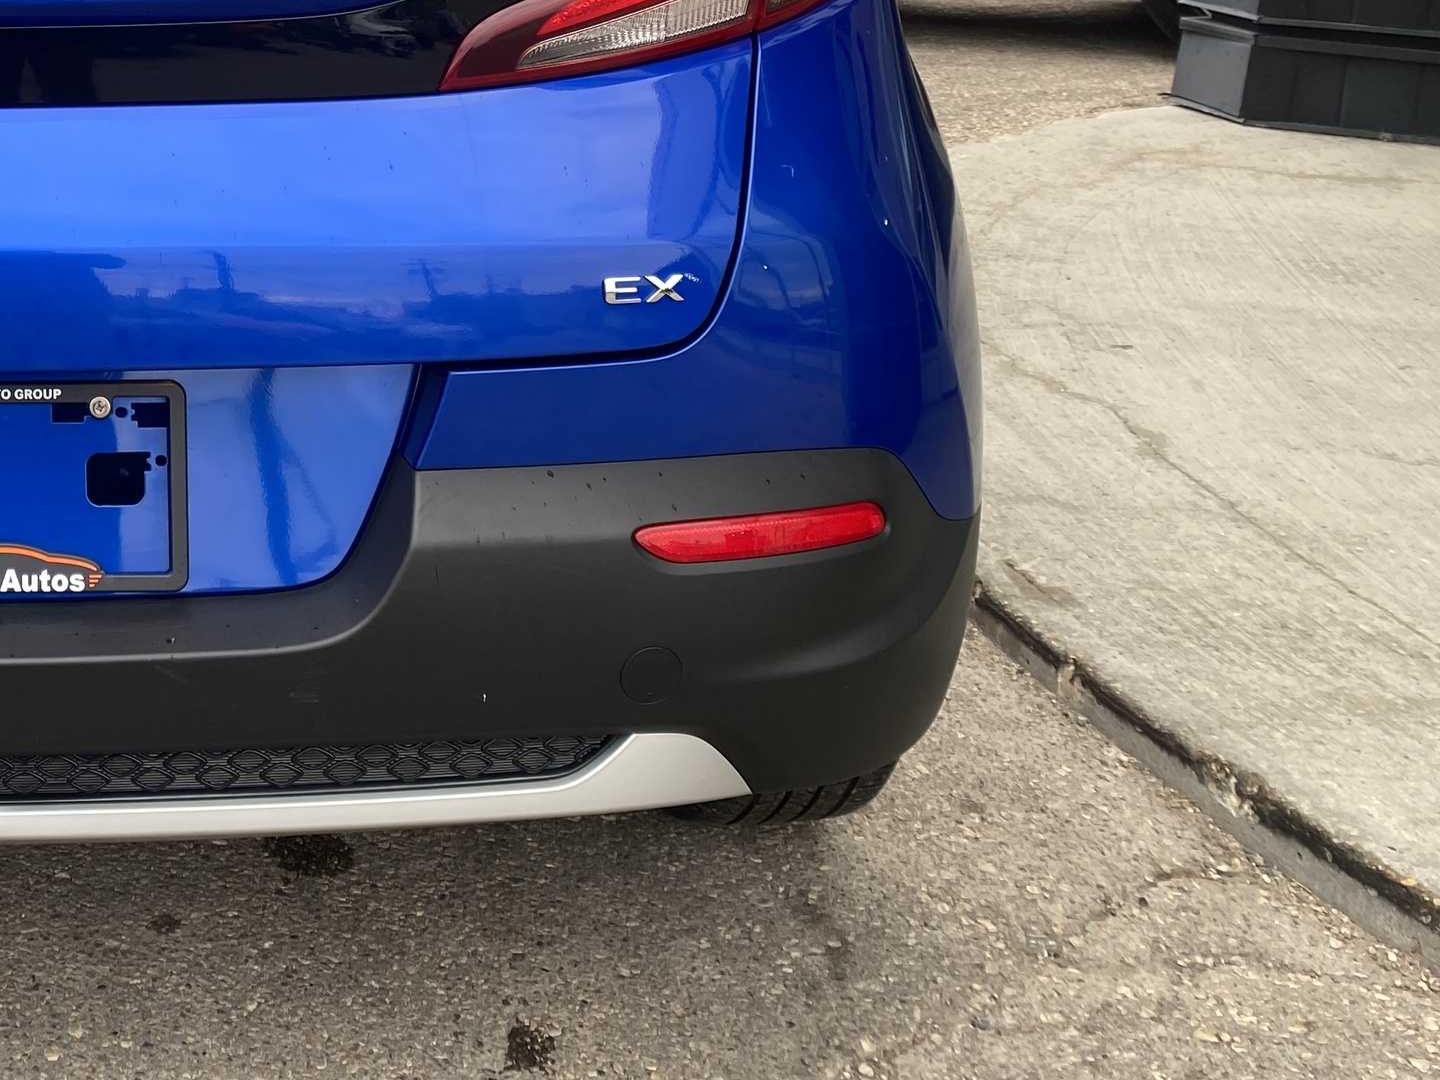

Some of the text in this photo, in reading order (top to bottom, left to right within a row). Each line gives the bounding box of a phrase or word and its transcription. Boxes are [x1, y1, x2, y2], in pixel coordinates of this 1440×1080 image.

[603, 273, 685, 305] EX
[14, 388, 62, 400] GROUP
[0, 569, 86, 593] Autos
